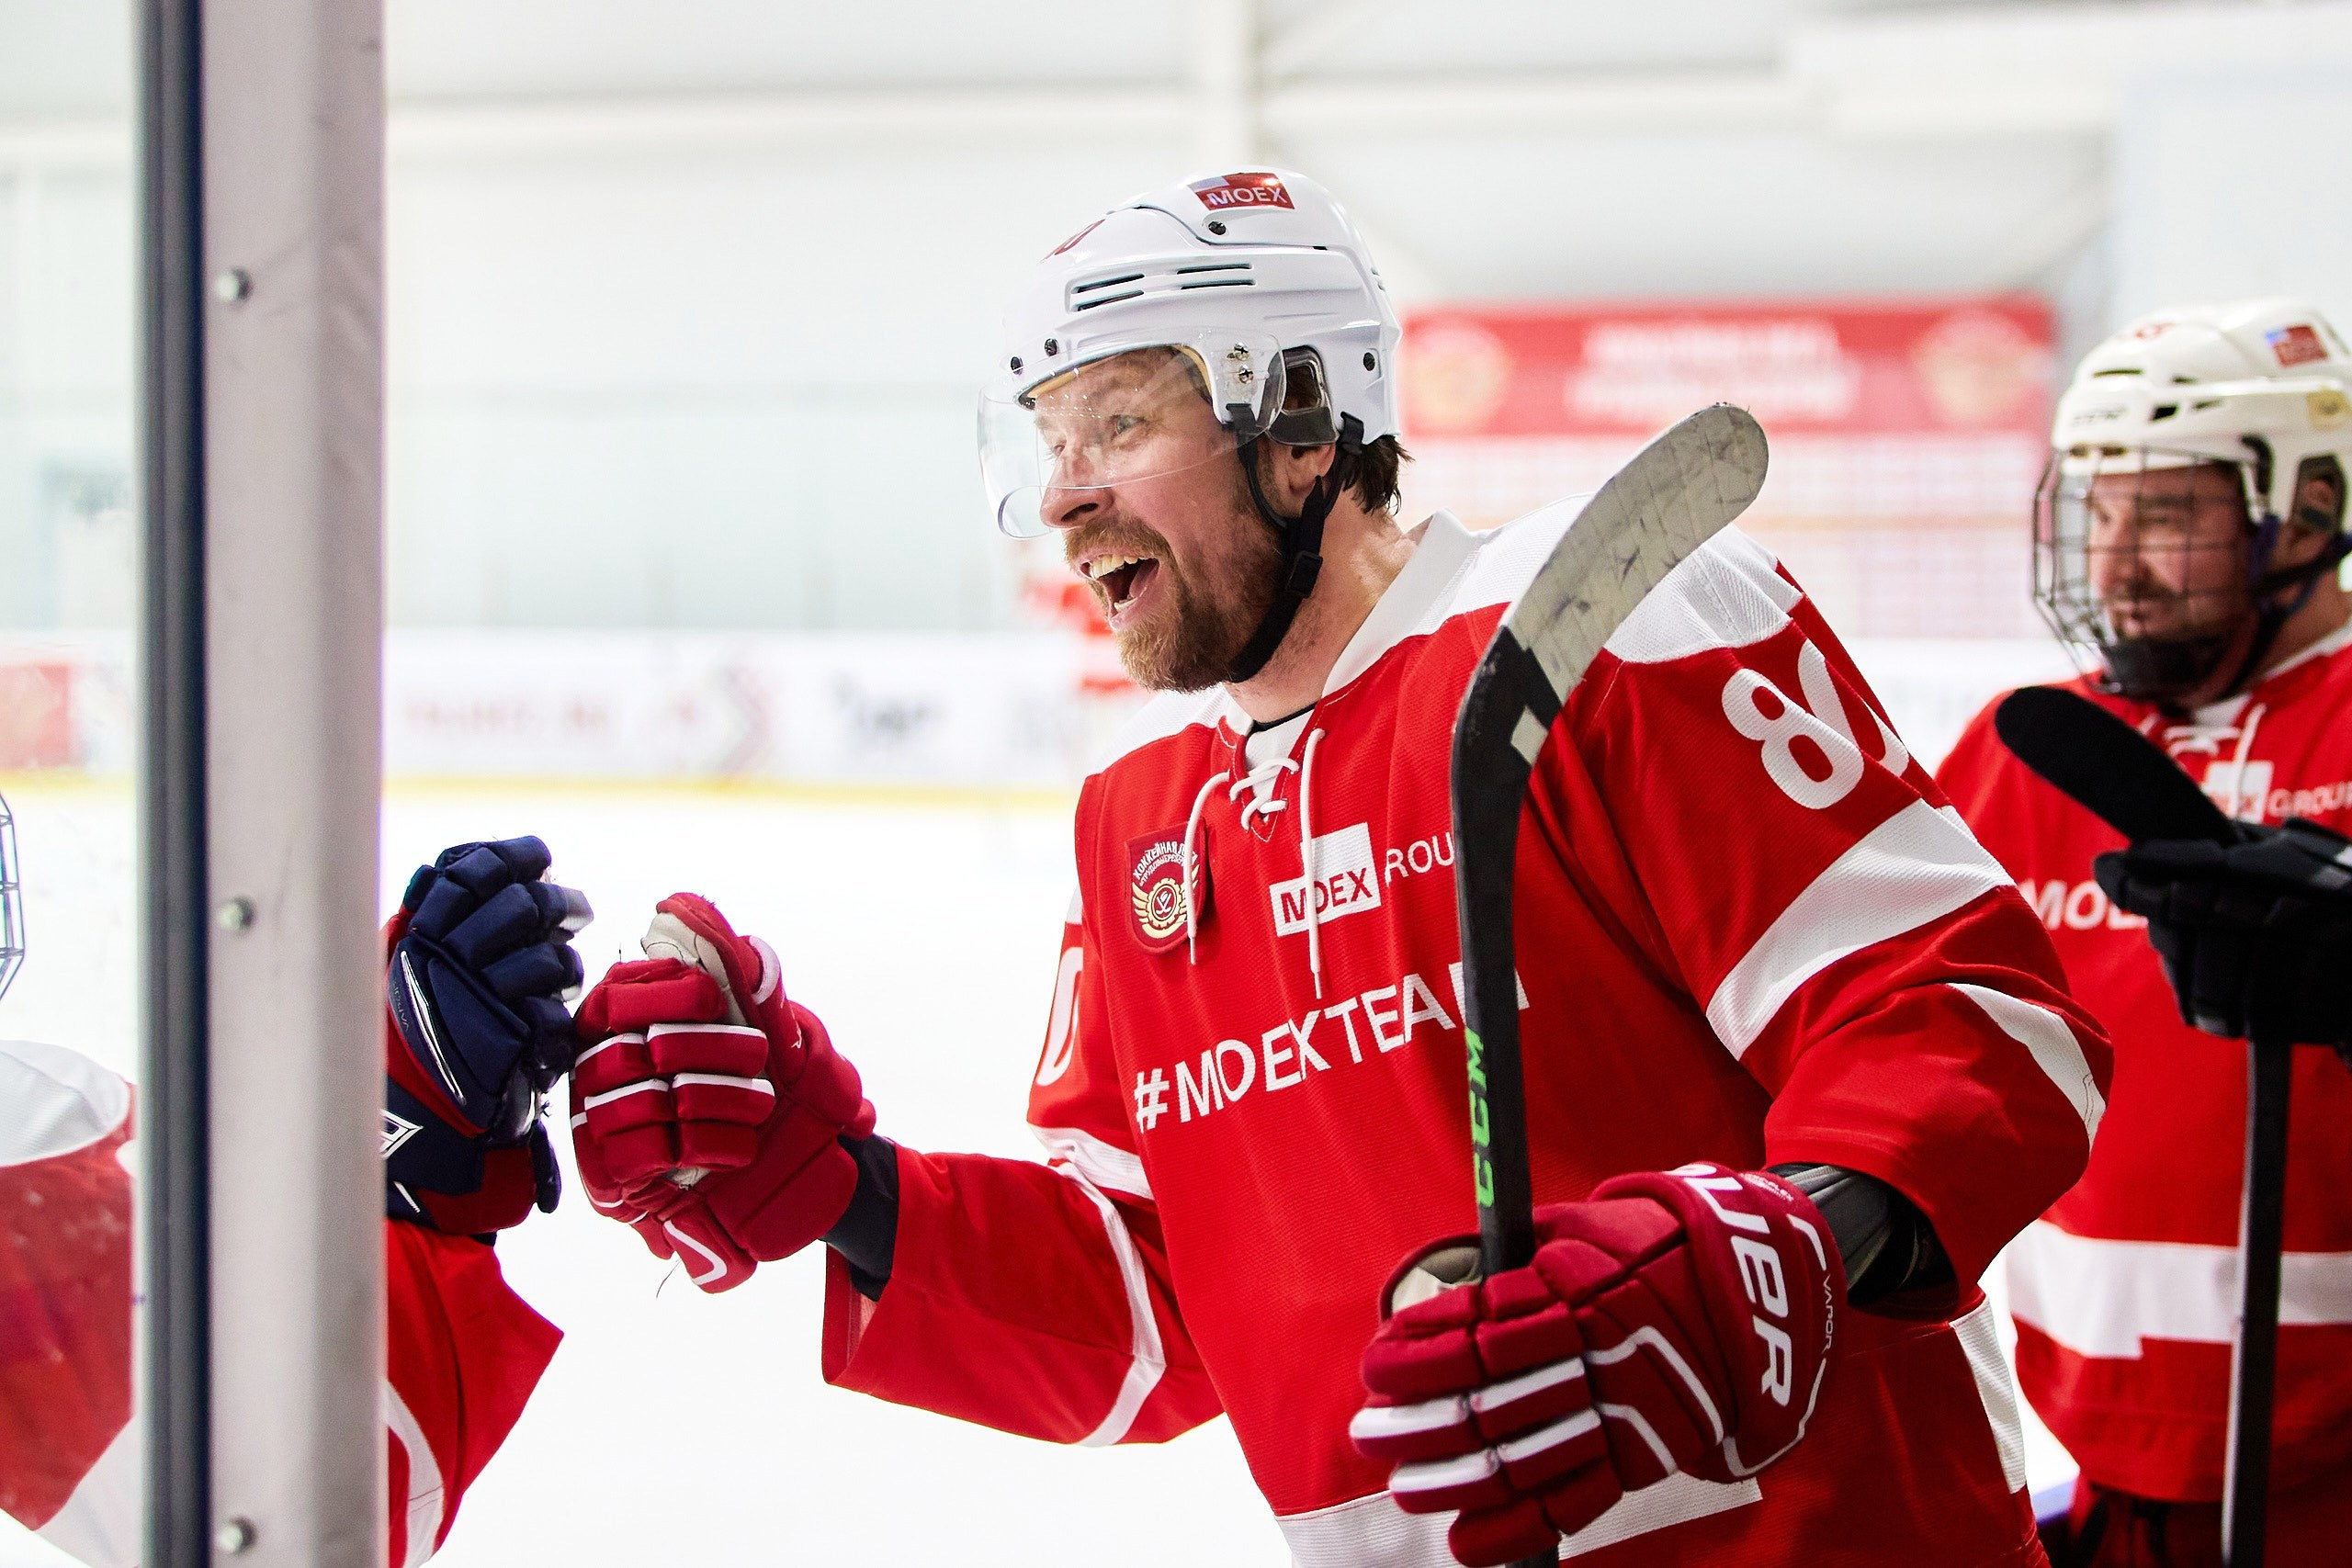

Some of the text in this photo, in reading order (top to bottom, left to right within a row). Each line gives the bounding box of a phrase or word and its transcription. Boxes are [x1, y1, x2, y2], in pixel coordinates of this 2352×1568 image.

[1206, 186, 1287, 205] MOEX
[2269, 781, 2352, 817] GROU
[1385, 831, 1455, 887] ROU
[1464, 1026, 1495, 1208] CCM
[1822, 1273, 1834, 1355] VAPOR
